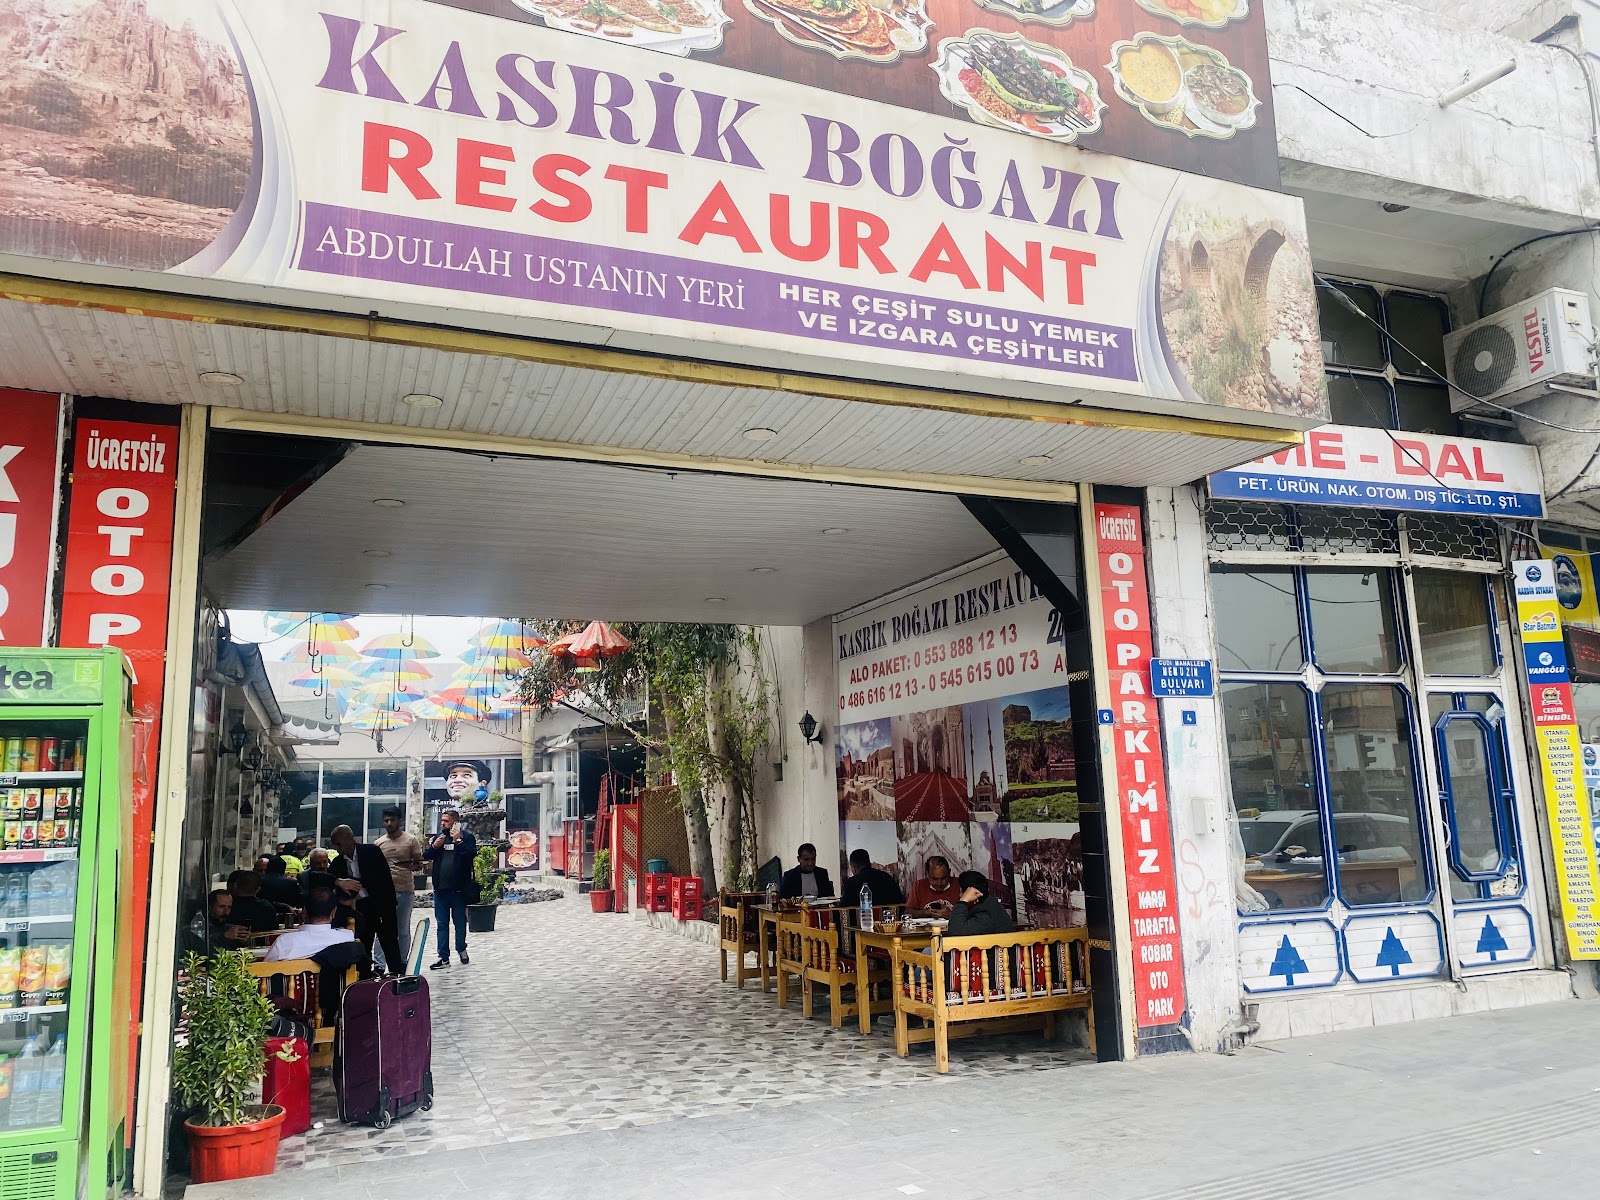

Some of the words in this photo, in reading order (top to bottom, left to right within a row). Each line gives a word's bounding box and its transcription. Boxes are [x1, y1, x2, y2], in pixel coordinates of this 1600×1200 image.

[315, 12, 764, 171] KASRİK
[802, 113, 1124, 240] BOĞAZI
[361, 121, 1096, 306] RESTAURANT
[316, 226, 511, 278] ABDULLAH
[523, 253, 667, 299] USTANIN
[675, 276, 745, 310] YERİ
[778, 282, 841, 308] HER
[856, 294, 937, 322] ÇEŞİT
[946, 308, 1019, 333] SULU
[1028, 320, 1119, 349] YEMEK
[797, 310, 838, 333] VE
[849, 317, 958, 349] IZGARA
[968, 335, 1105, 369] ÇEŞİTLERİ
[1523, 306, 1544, 373] VESTEL
[87, 429, 166, 473] ÜCRETSİZ
[1391, 438, 1504, 483] DAL
[1238, 476, 1273, 492] PET.
[1277, 477, 1324, 495] ÜRÜN.
[1327, 483, 1362, 498] NAK.
[1366, 485, 1411, 501] OTOM.
[1414, 489, 1436, 504] DIŞ
[1467, 493, 1495, 507] LTD.
[1499, 493, 1521, 509] ŞTİ.
[1100, 512, 1136, 541] ÜCRETSİZ
[88, 487, 149, 684] OTOP
[839, 620, 887, 659] KASRİK
[891, 605, 949, 645] BOĞAZI
[1524, 622, 1536, 631] Star
[1536, 622, 1557, 630] Batman
[850, 666, 869, 685] ALO
[872, 655, 911, 679] PAKET:
[914, 653, 921, 668] 0
[924, 644, 946, 664] 553
[950, 636, 973, 659] 888
[978, 629, 995, 652] 12
[1000, 623, 1018, 646] 13
[1054, 653, 1067, 674] A
[0, 665, 53, 690] tea
[840, 695, 845, 710] 0
[848, 691, 865, 709] 486
[867, 686, 886, 704] 616
[888, 682, 902, 699] 12
[904, 678, 918, 697] 13
[929, 674, 936, 692] 0
[940, 667, 962, 688] 545
[967, 660, 992, 683] 615
[996, 655, 1015, 677] 00
[1020, 649, 1039, 672] 73
[1529, 664, 1565, 675] VANGÖLÜ
[1160, 678, 1205, 689] BULVARI
[1102, 712, 1110, 722] 6
[1186, 713, 1192, 722] 4
[1536, 713, 1572, 722] BİNGÖL
[1138, 890, 1167, 911] KARŞI
[1134, 916, 1176, 937] TARAFTA
[1141, 943, 1173, 964] ROBAR
[1150, 971, 1169, 990] OTO
[20, 991, 40, 999] Cappy
[1148, 997, 1174, 1019] PARK
